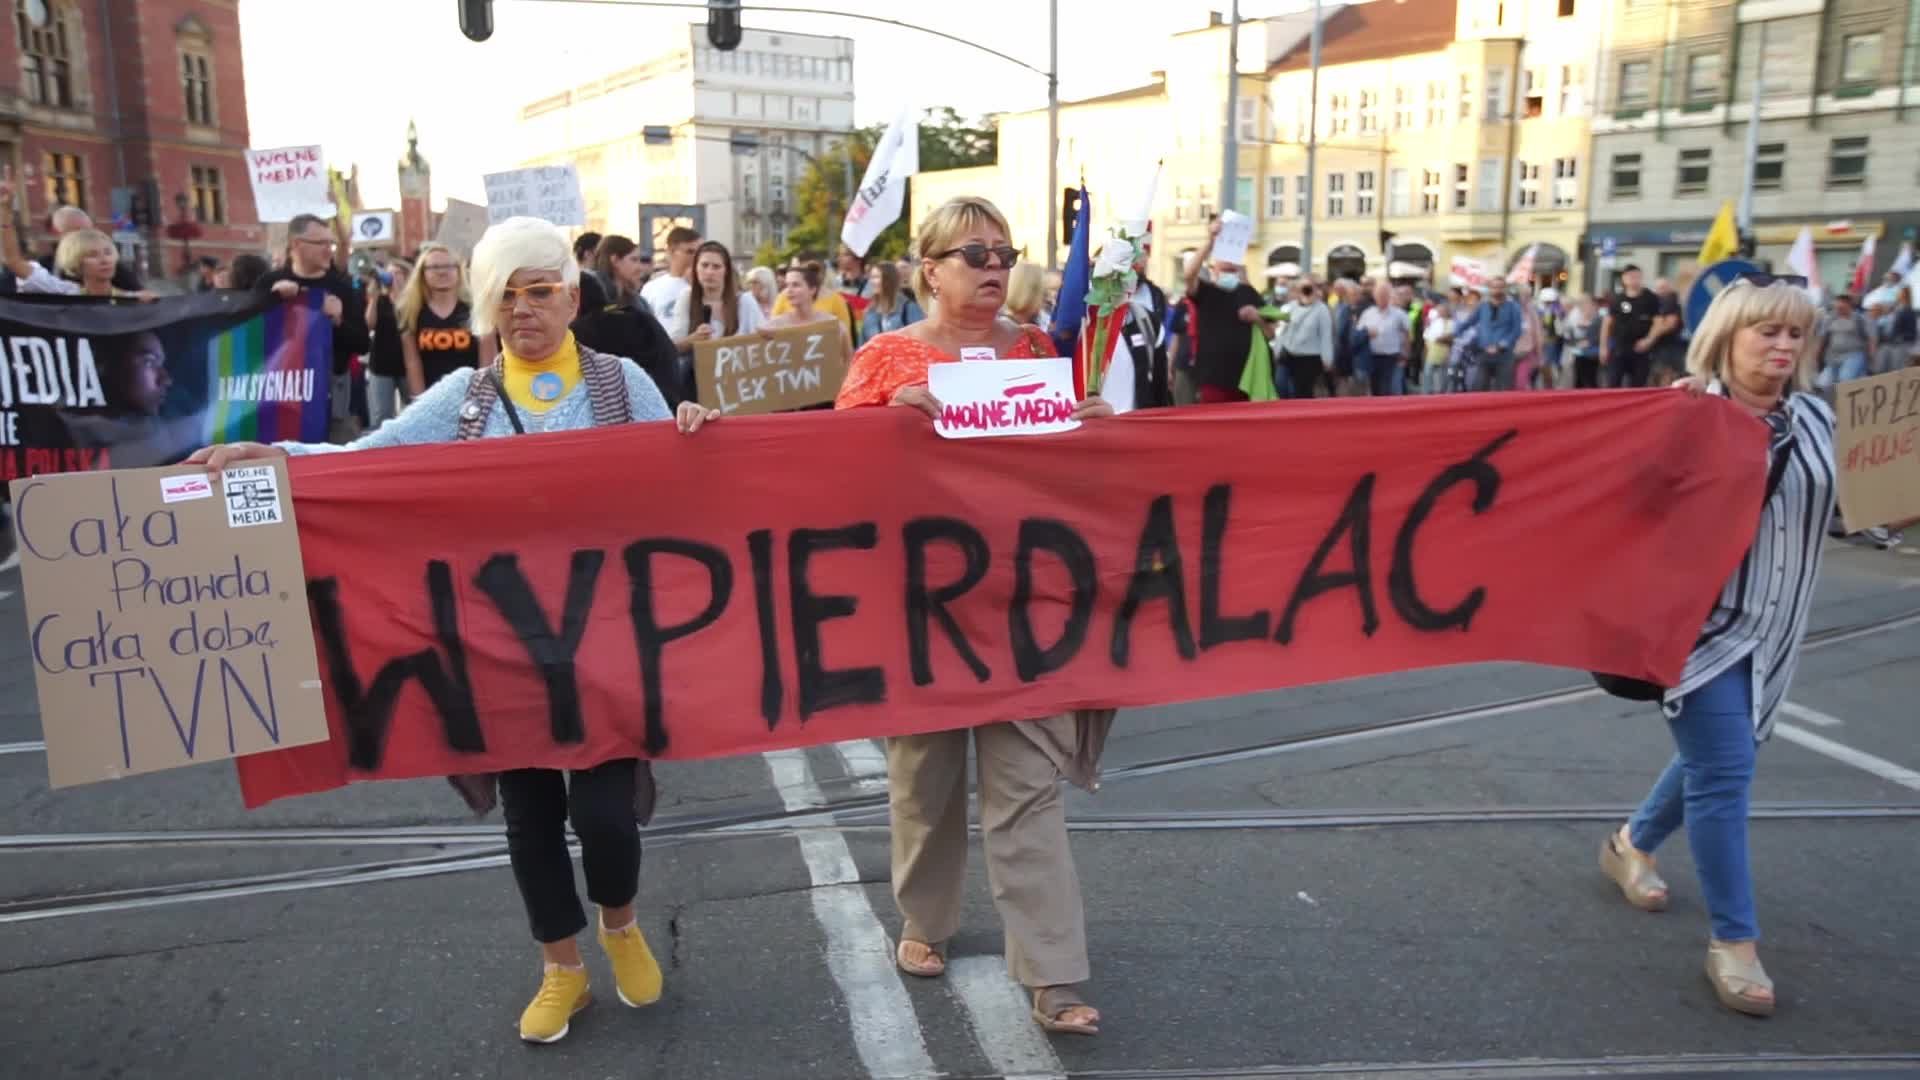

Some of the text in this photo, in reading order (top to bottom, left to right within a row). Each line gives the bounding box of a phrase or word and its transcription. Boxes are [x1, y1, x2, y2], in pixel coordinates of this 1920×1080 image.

[255, 147, 318, 168] WOLNE
[419, 328, 471, 351] KOD
[715, 334, 824, 377] PRECZ Z
[715, 367, 821, 414] LEX TVN
[940, 400, 1012, 431] WOLNE
[16, 476, 179, 561] Cała
[233, 508, 277, 525] MEDIA
[306, 427, 1519, 773] WYPIERDALAĆ
[32, 609, 146, 674] Cała
[89, 652, 280, 769] TVN
